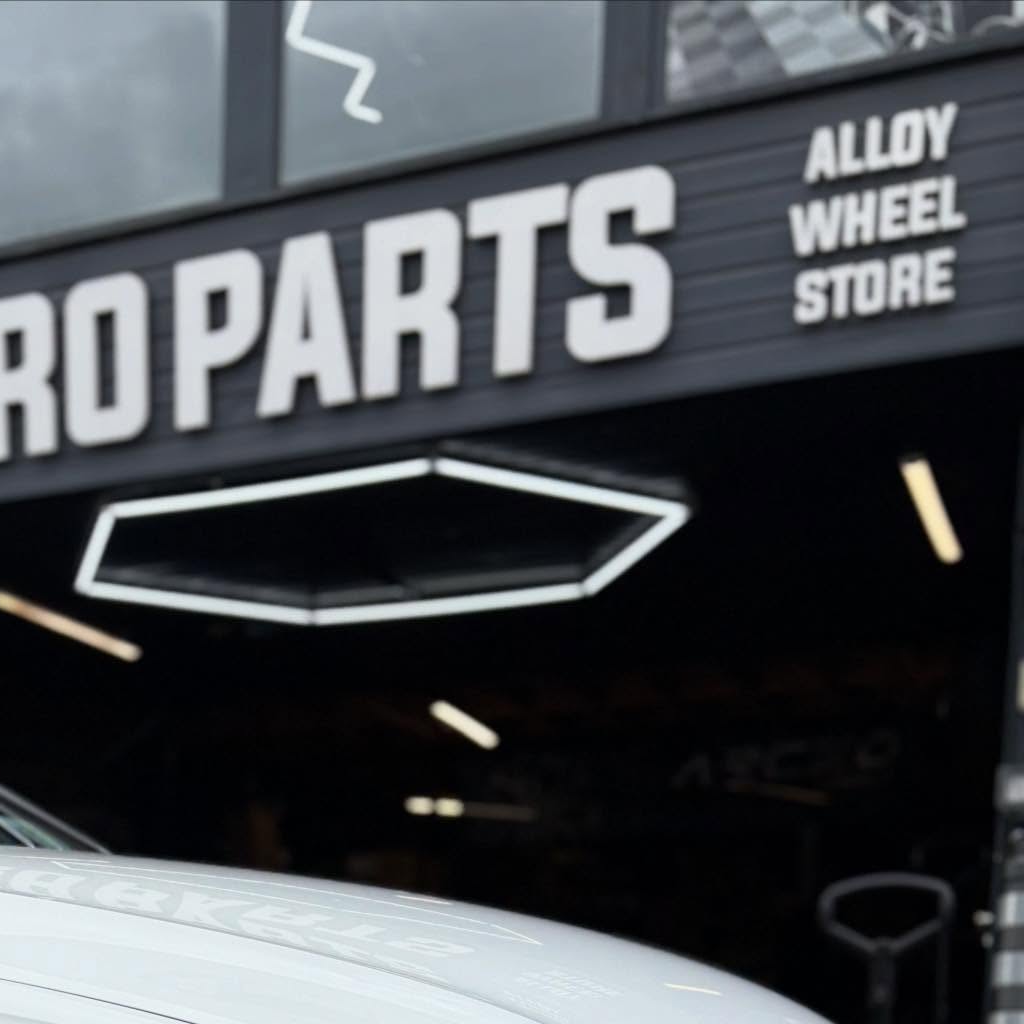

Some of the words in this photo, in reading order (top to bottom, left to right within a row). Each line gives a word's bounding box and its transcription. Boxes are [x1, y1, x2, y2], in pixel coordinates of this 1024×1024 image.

[803, 101, 958, 184] ALLOY
[788, 174, 968, 257] WHEEL
[174, 165, 676, 433] PARTS
[793, 245, 957, 325] STORE
